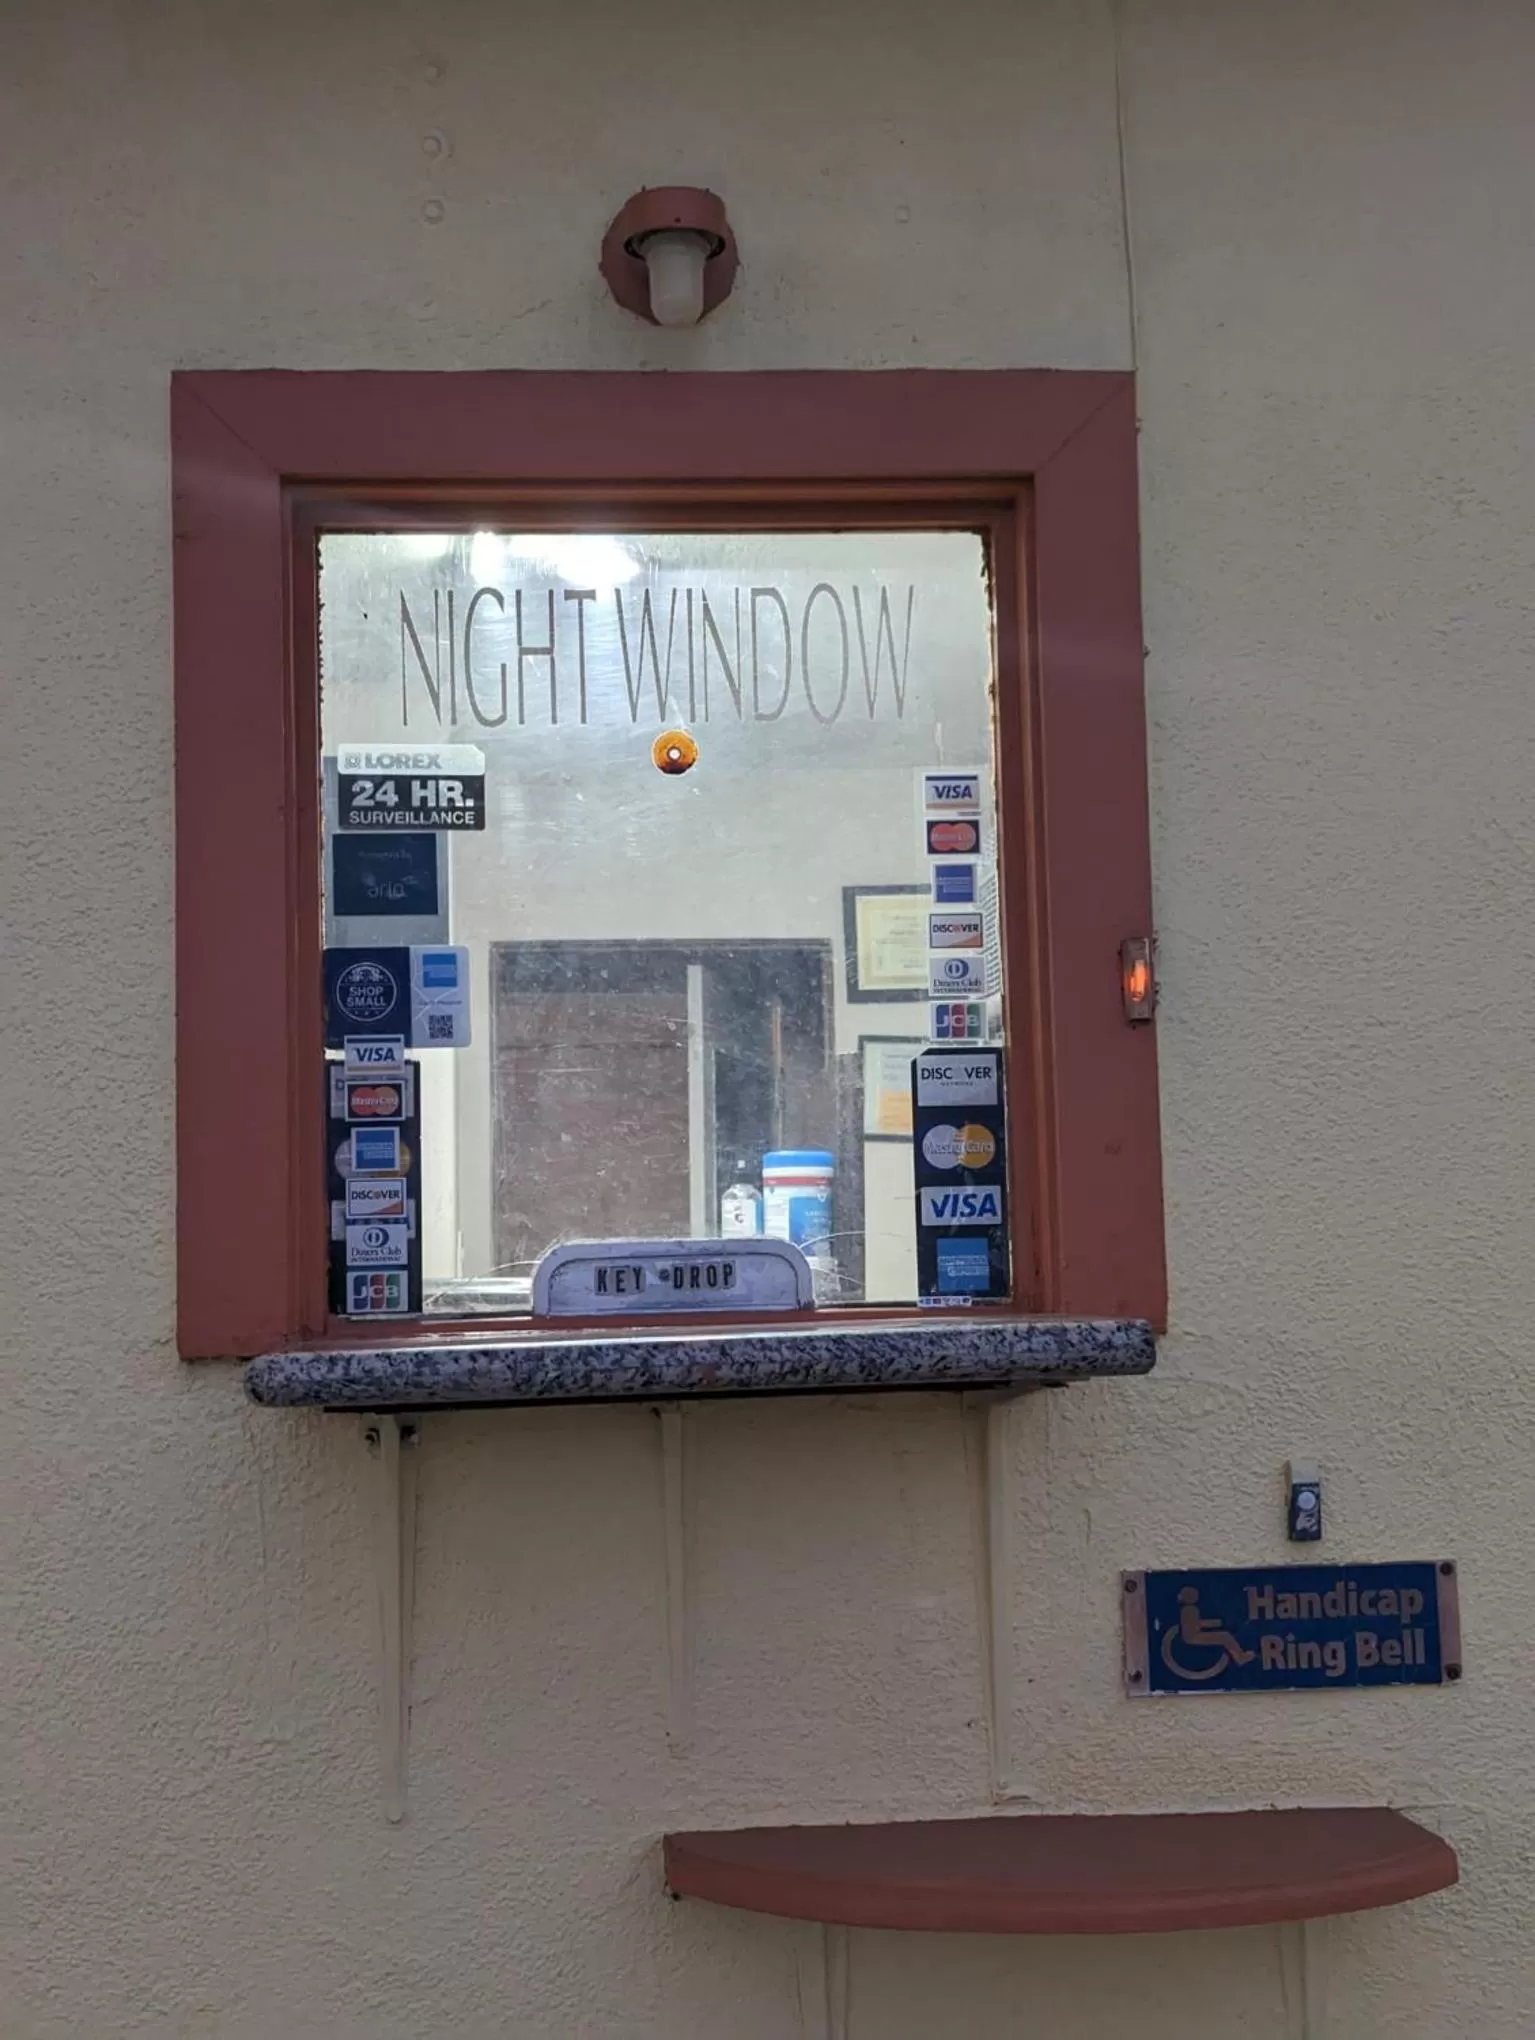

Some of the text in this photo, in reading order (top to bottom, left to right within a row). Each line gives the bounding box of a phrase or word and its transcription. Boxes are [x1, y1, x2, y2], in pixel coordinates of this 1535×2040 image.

[400, 583, 915, 728] NIGHT WINDOW
[365, 753, 443, 769] LOREX
[351, 780, 475, 808] 24 HR.
[933, 785, 973, 799] VISA
[350, 811, 476, 825] SURVEILLANCE
[932, 923, 979, 934] DISCOVER
[349, 986, 384, 997] SHOP
[346, 997, 387, 1007] SMALL
[936, 1015, 980, 1028] JCB
[354, 1047, 396, 1062] VISA
[920, 1067, 993, 1080] DISCVER
[351, 1189, 400, 1200] DISCOVER
[930, 1193, 998, 1219] VISA
[596, 1262, 734, 1293] KEY DROP
[353, 1285, 399, 1299] JCB
[1247, 1580, 1424, 1624] Handicap
[1259, 1628, 1425, 1677] Ring Bell
